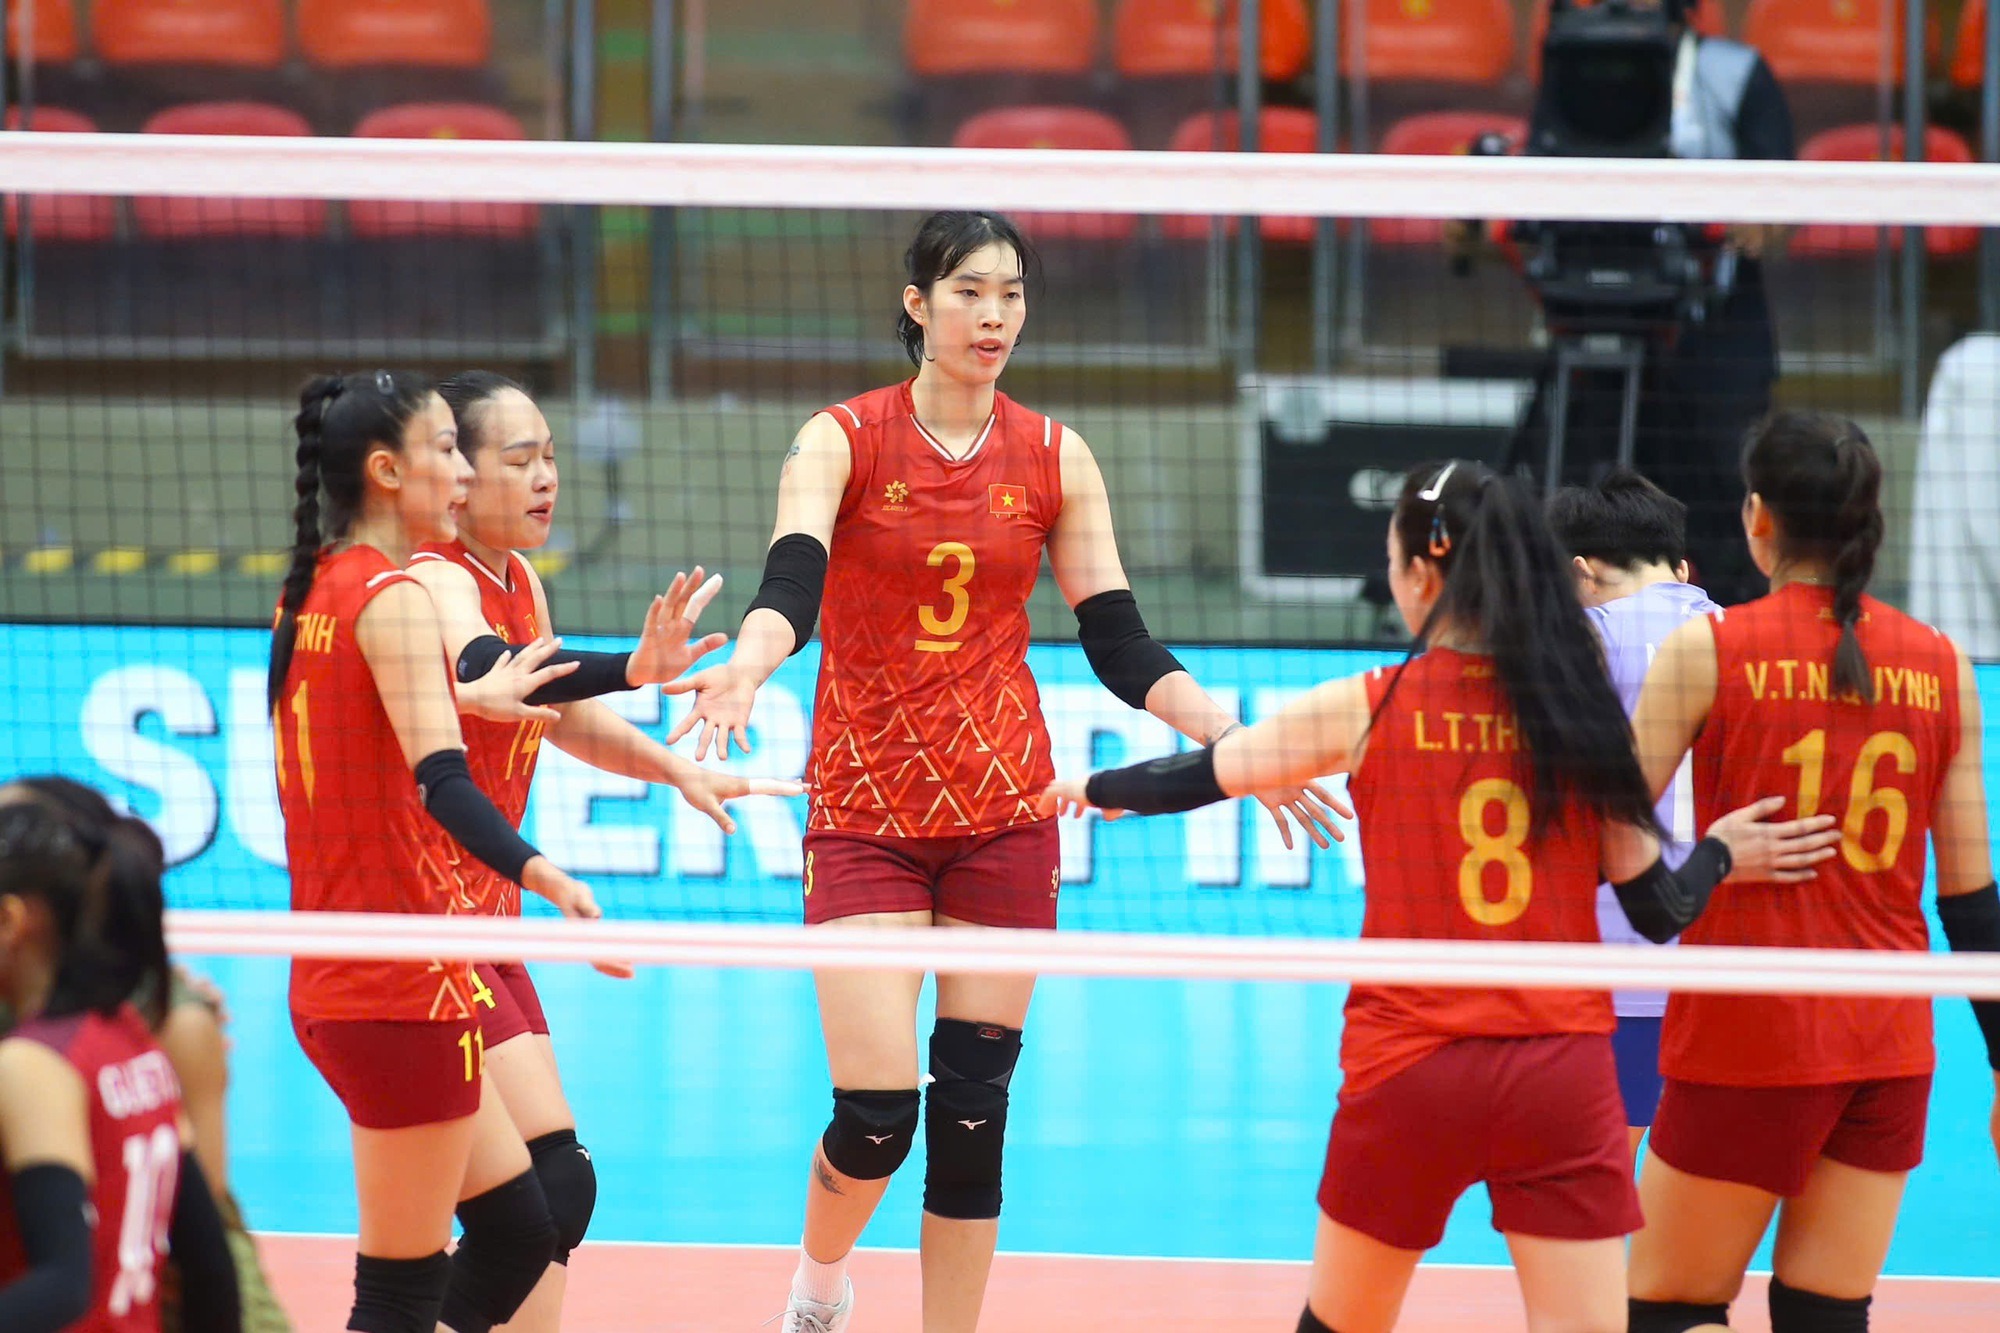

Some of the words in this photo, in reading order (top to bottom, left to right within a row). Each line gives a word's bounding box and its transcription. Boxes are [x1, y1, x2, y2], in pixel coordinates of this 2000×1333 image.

[918, 541, 976, 636] 3
[80, 664, 811, 880] SER
[1782, 728, 1917, 873] 16
[1458, 778, 1533, 926] 8
[458, 1025, 485, 1082] 11
